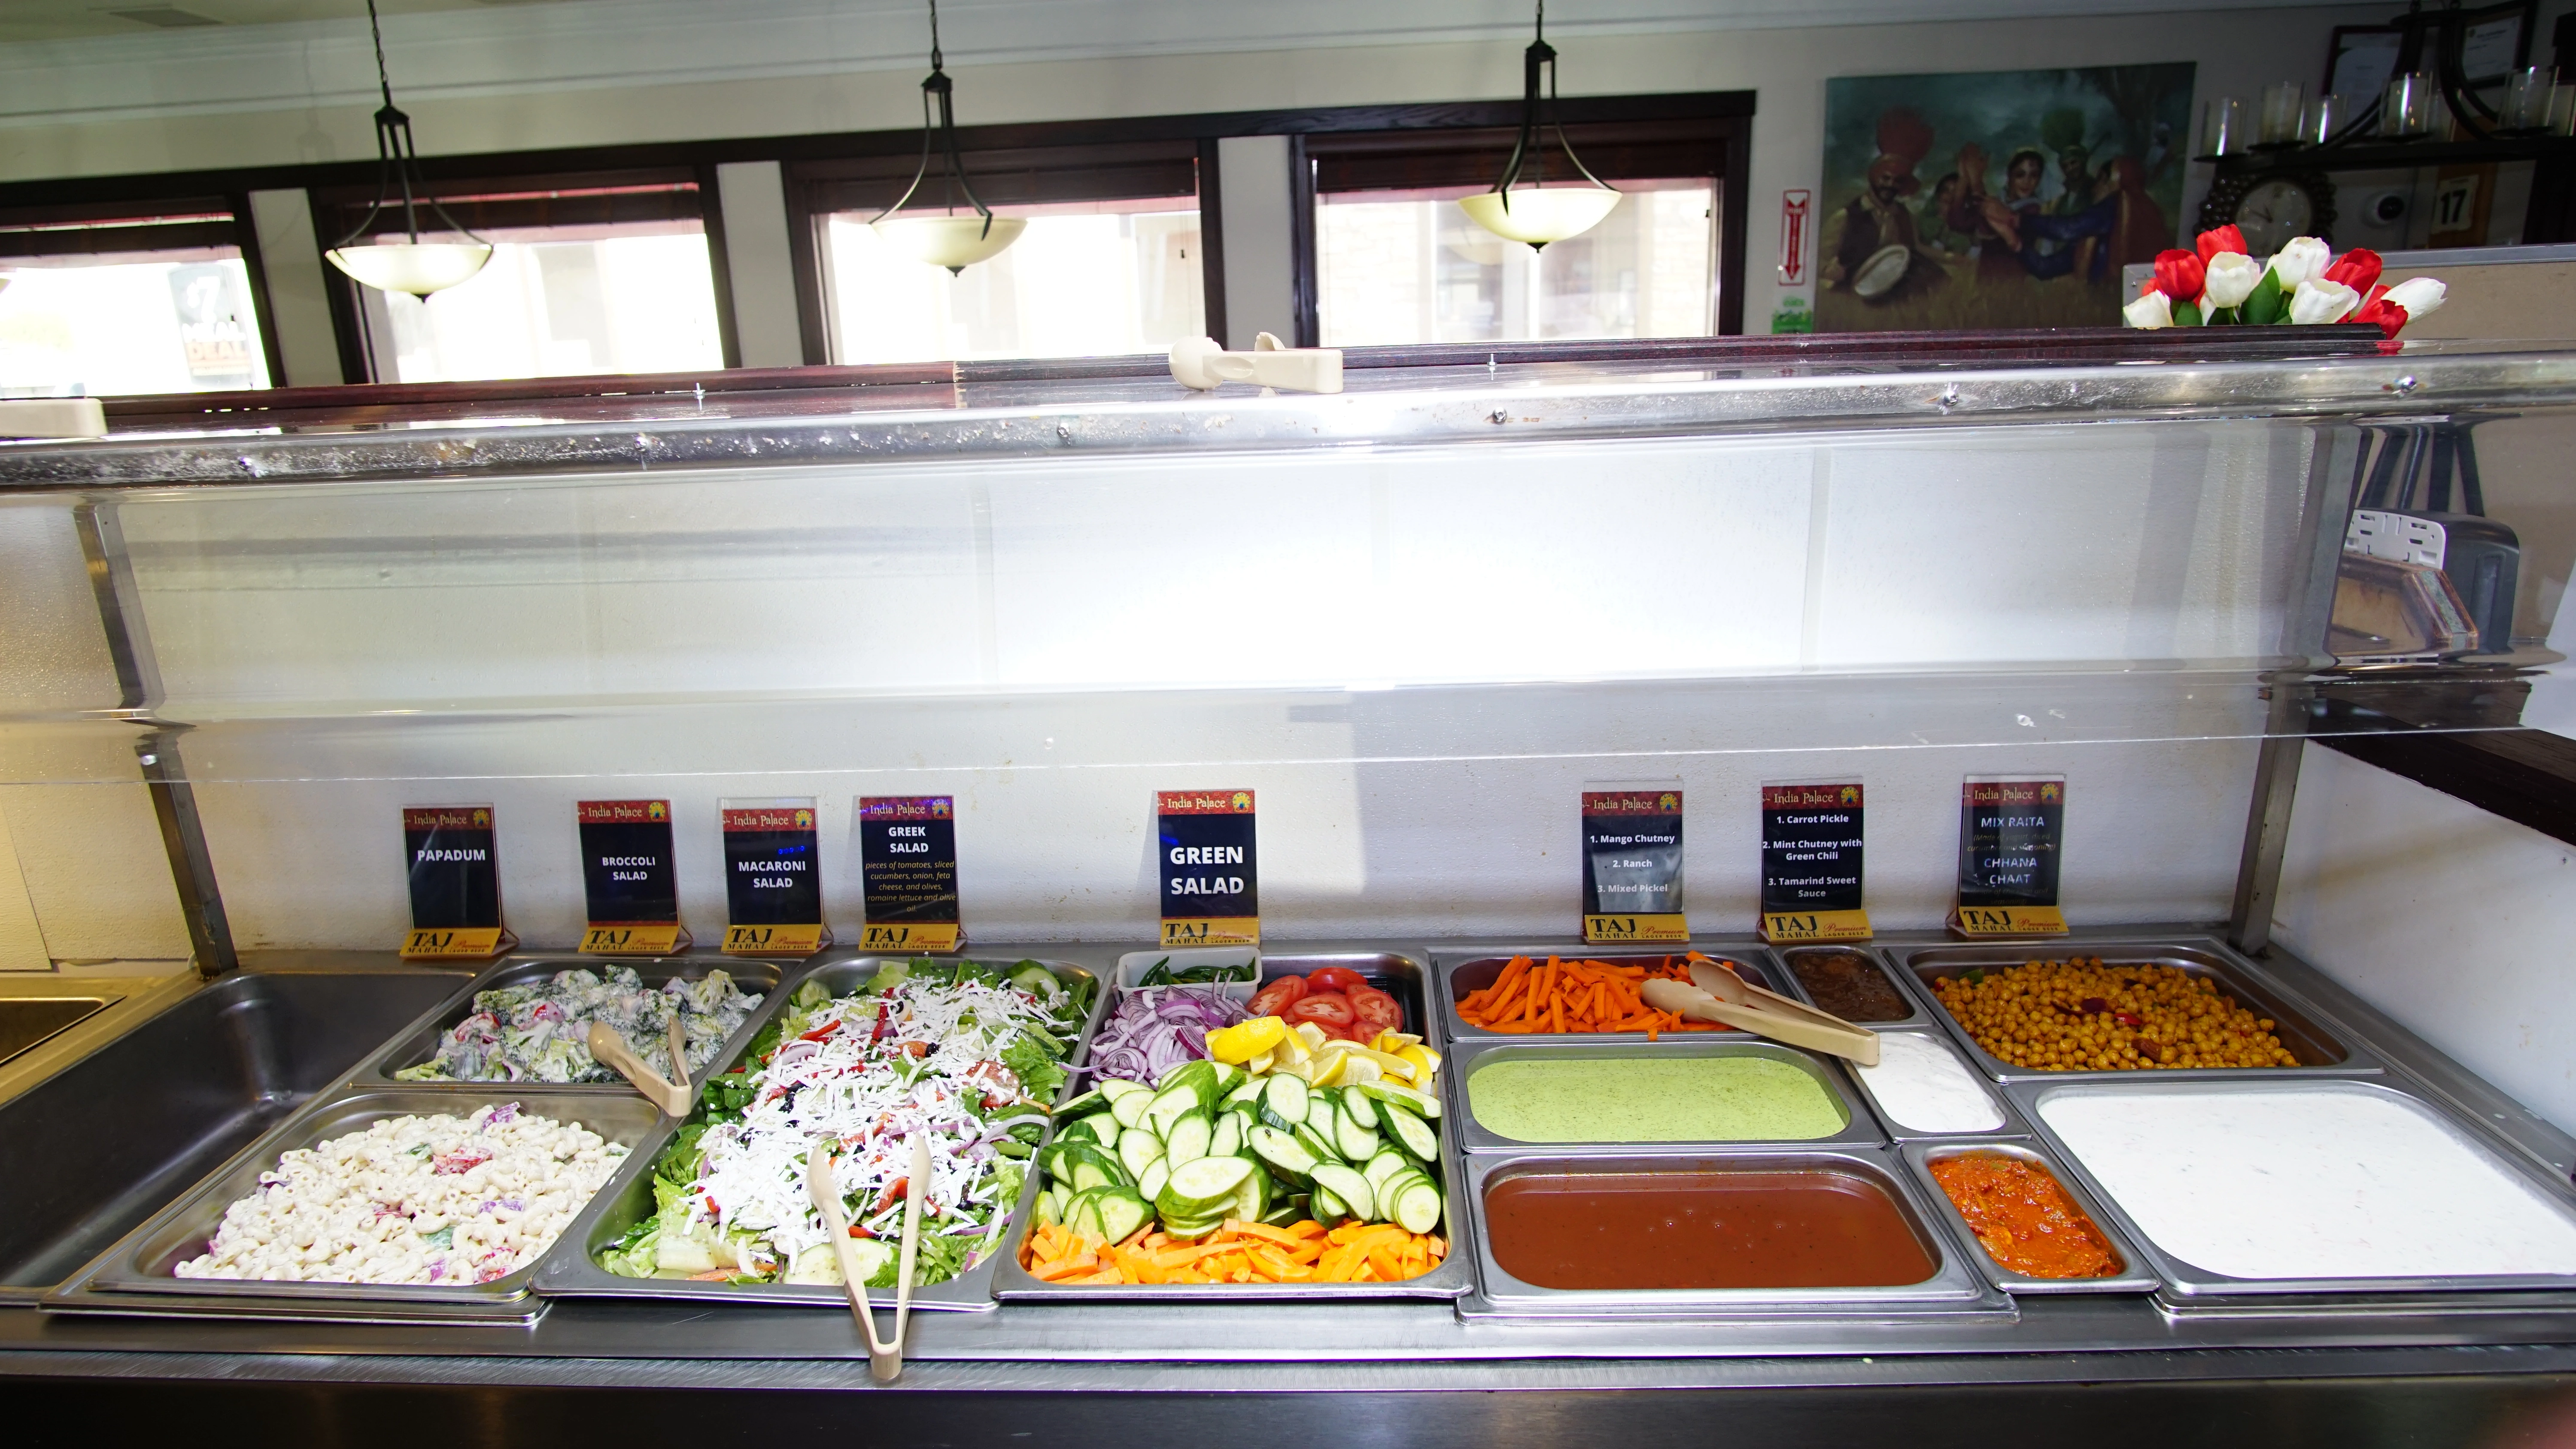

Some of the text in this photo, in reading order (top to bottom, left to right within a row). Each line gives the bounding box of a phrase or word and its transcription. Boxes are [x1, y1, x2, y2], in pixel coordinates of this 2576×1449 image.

[2441, 188, 2467, 224] 17
[185, 342, 246, 360] DEAL
[1774, 791, 1833, 804] India Palace
[1975, 787, 2033, 802] India Palace
[1168, 796, 1225, 809] India Palace
[1594, 797, 1652, 811] India Palace
[588, 805, 642, 819] India Palace
[870, 802, 925, 816] India Palace
[414, 812, 467, 826] India Palace
[734, 813, 789, 827] India Palace
[1787, 815, 1817, 824] Carrot
[1981, 816, 2044, 827] MIX RAITA
[889, 827, 926, 837] GREEK
[1601, 835, 1632, 844] Mango
[1635, 835, 1675, 843] Chutney
[1798, 840, 1838, 849] Chutney
[1841, 839, 1862, 847] with
[890, 843, 928, 853] SALAD
[417, 849, 486, 861] PAPADUM
[1170, 846, 1243, 864] GREEN
[1817, 852, 1838, 860] Chili
[602, 857, 656, 866] BROCCOLI
[738, 861, 806, 871] MACARONI
[866, 862, 887, 870] pieces
[889, 861, 897, 870] of
[1984, 858, 2037, 868] CHHANA
[613, 871, 647, 880] SALAD
[936, 872, 950, 881] feta
[1779, 876, 1824, 885] Tamarind
[1990, 874, 2030, 885] CHAAT
[753, 878, 793, 888] SALAD
[1171, 877, 1244, 894] SALAD
[1640, 884, 1668, 892] Pickel
[1770, 915, 1817, 931] TAJ
[1963, 911, 2011, 925] TAJ
[1166, 923, 1208, 938] TAJ
[1591, 919, 1636, 933] TAJ
[1641, 926, 1684, 934] Premium
[1823, 923, 1867, 932] Premium
[414, 932, 453, 947] TAJ
[591, 930, 631, 944] TAJ
[732, 929, 772, 943] TAJ
[868, 928, 909, 943] TAJ
